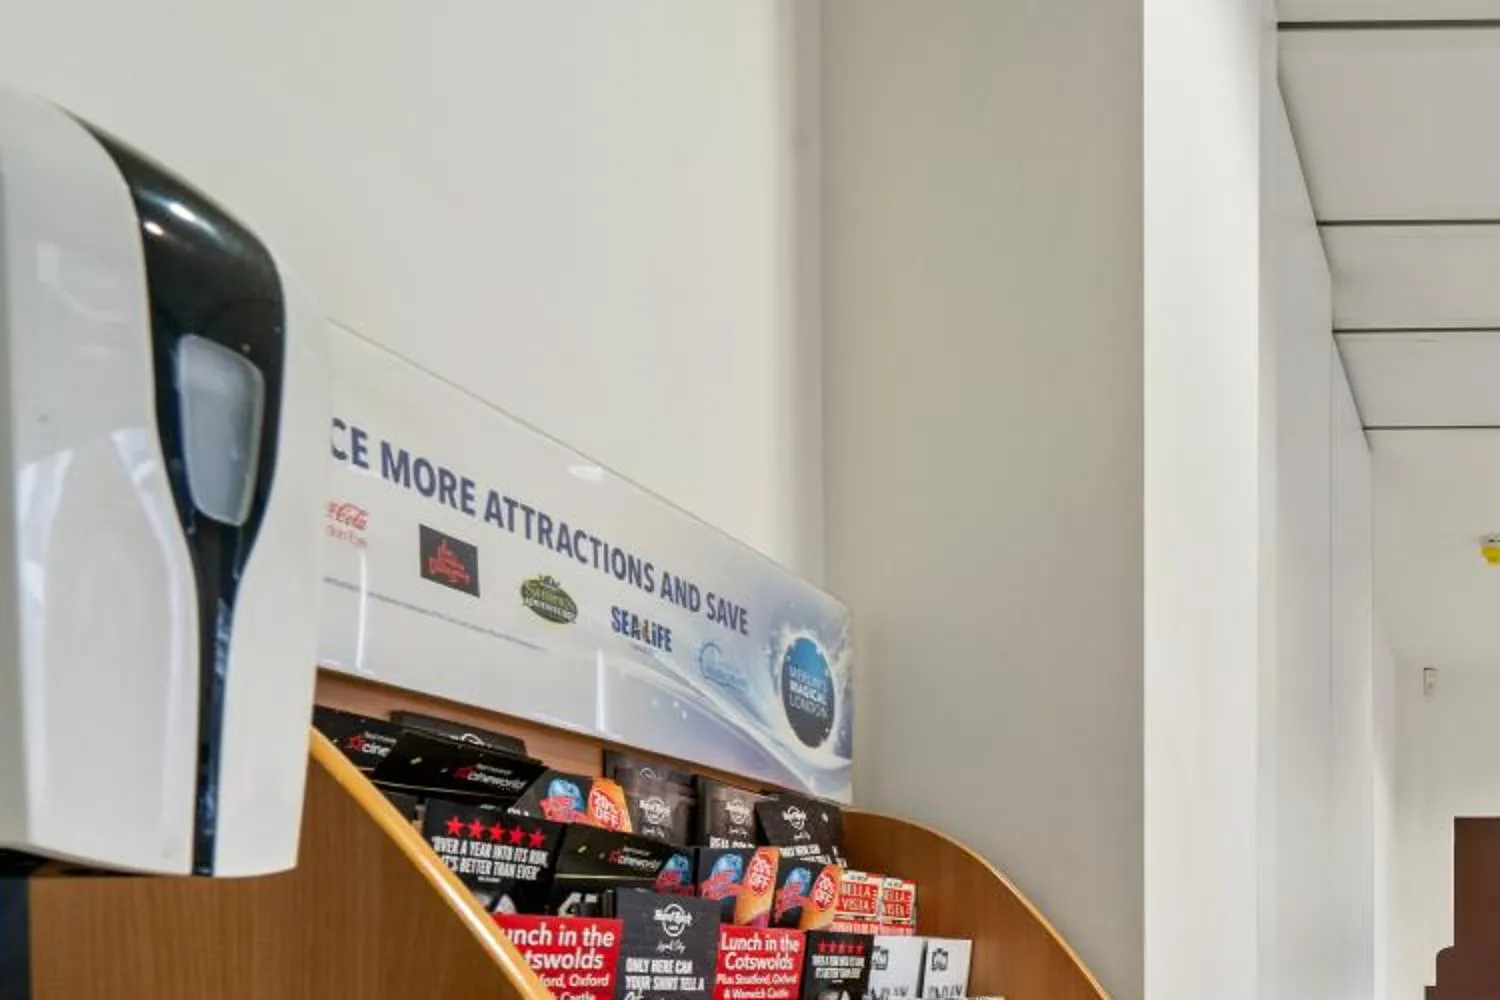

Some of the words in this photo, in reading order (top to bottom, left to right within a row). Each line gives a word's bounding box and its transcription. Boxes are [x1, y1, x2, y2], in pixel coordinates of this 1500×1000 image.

[380, 439, 477, 517] MORE
[484, 488, 656, 594] ATTRACTIONS
[660, 571, 701, 614] AND
[706, 590, 749, 637] SAVE
[611, 605, 641, 641] SEA
[503, 921, 552, 946] unch
[558, 924, 577, 946] in
[583, 923, 615, 947] the
[721, 932, 762, 951] Lunch
[765, 933, 777, 951] in
[780, 933, 800, 952] the
[524, 947, 604, 970] tswolds
[725, 951, 793, 970] Cotswolds
